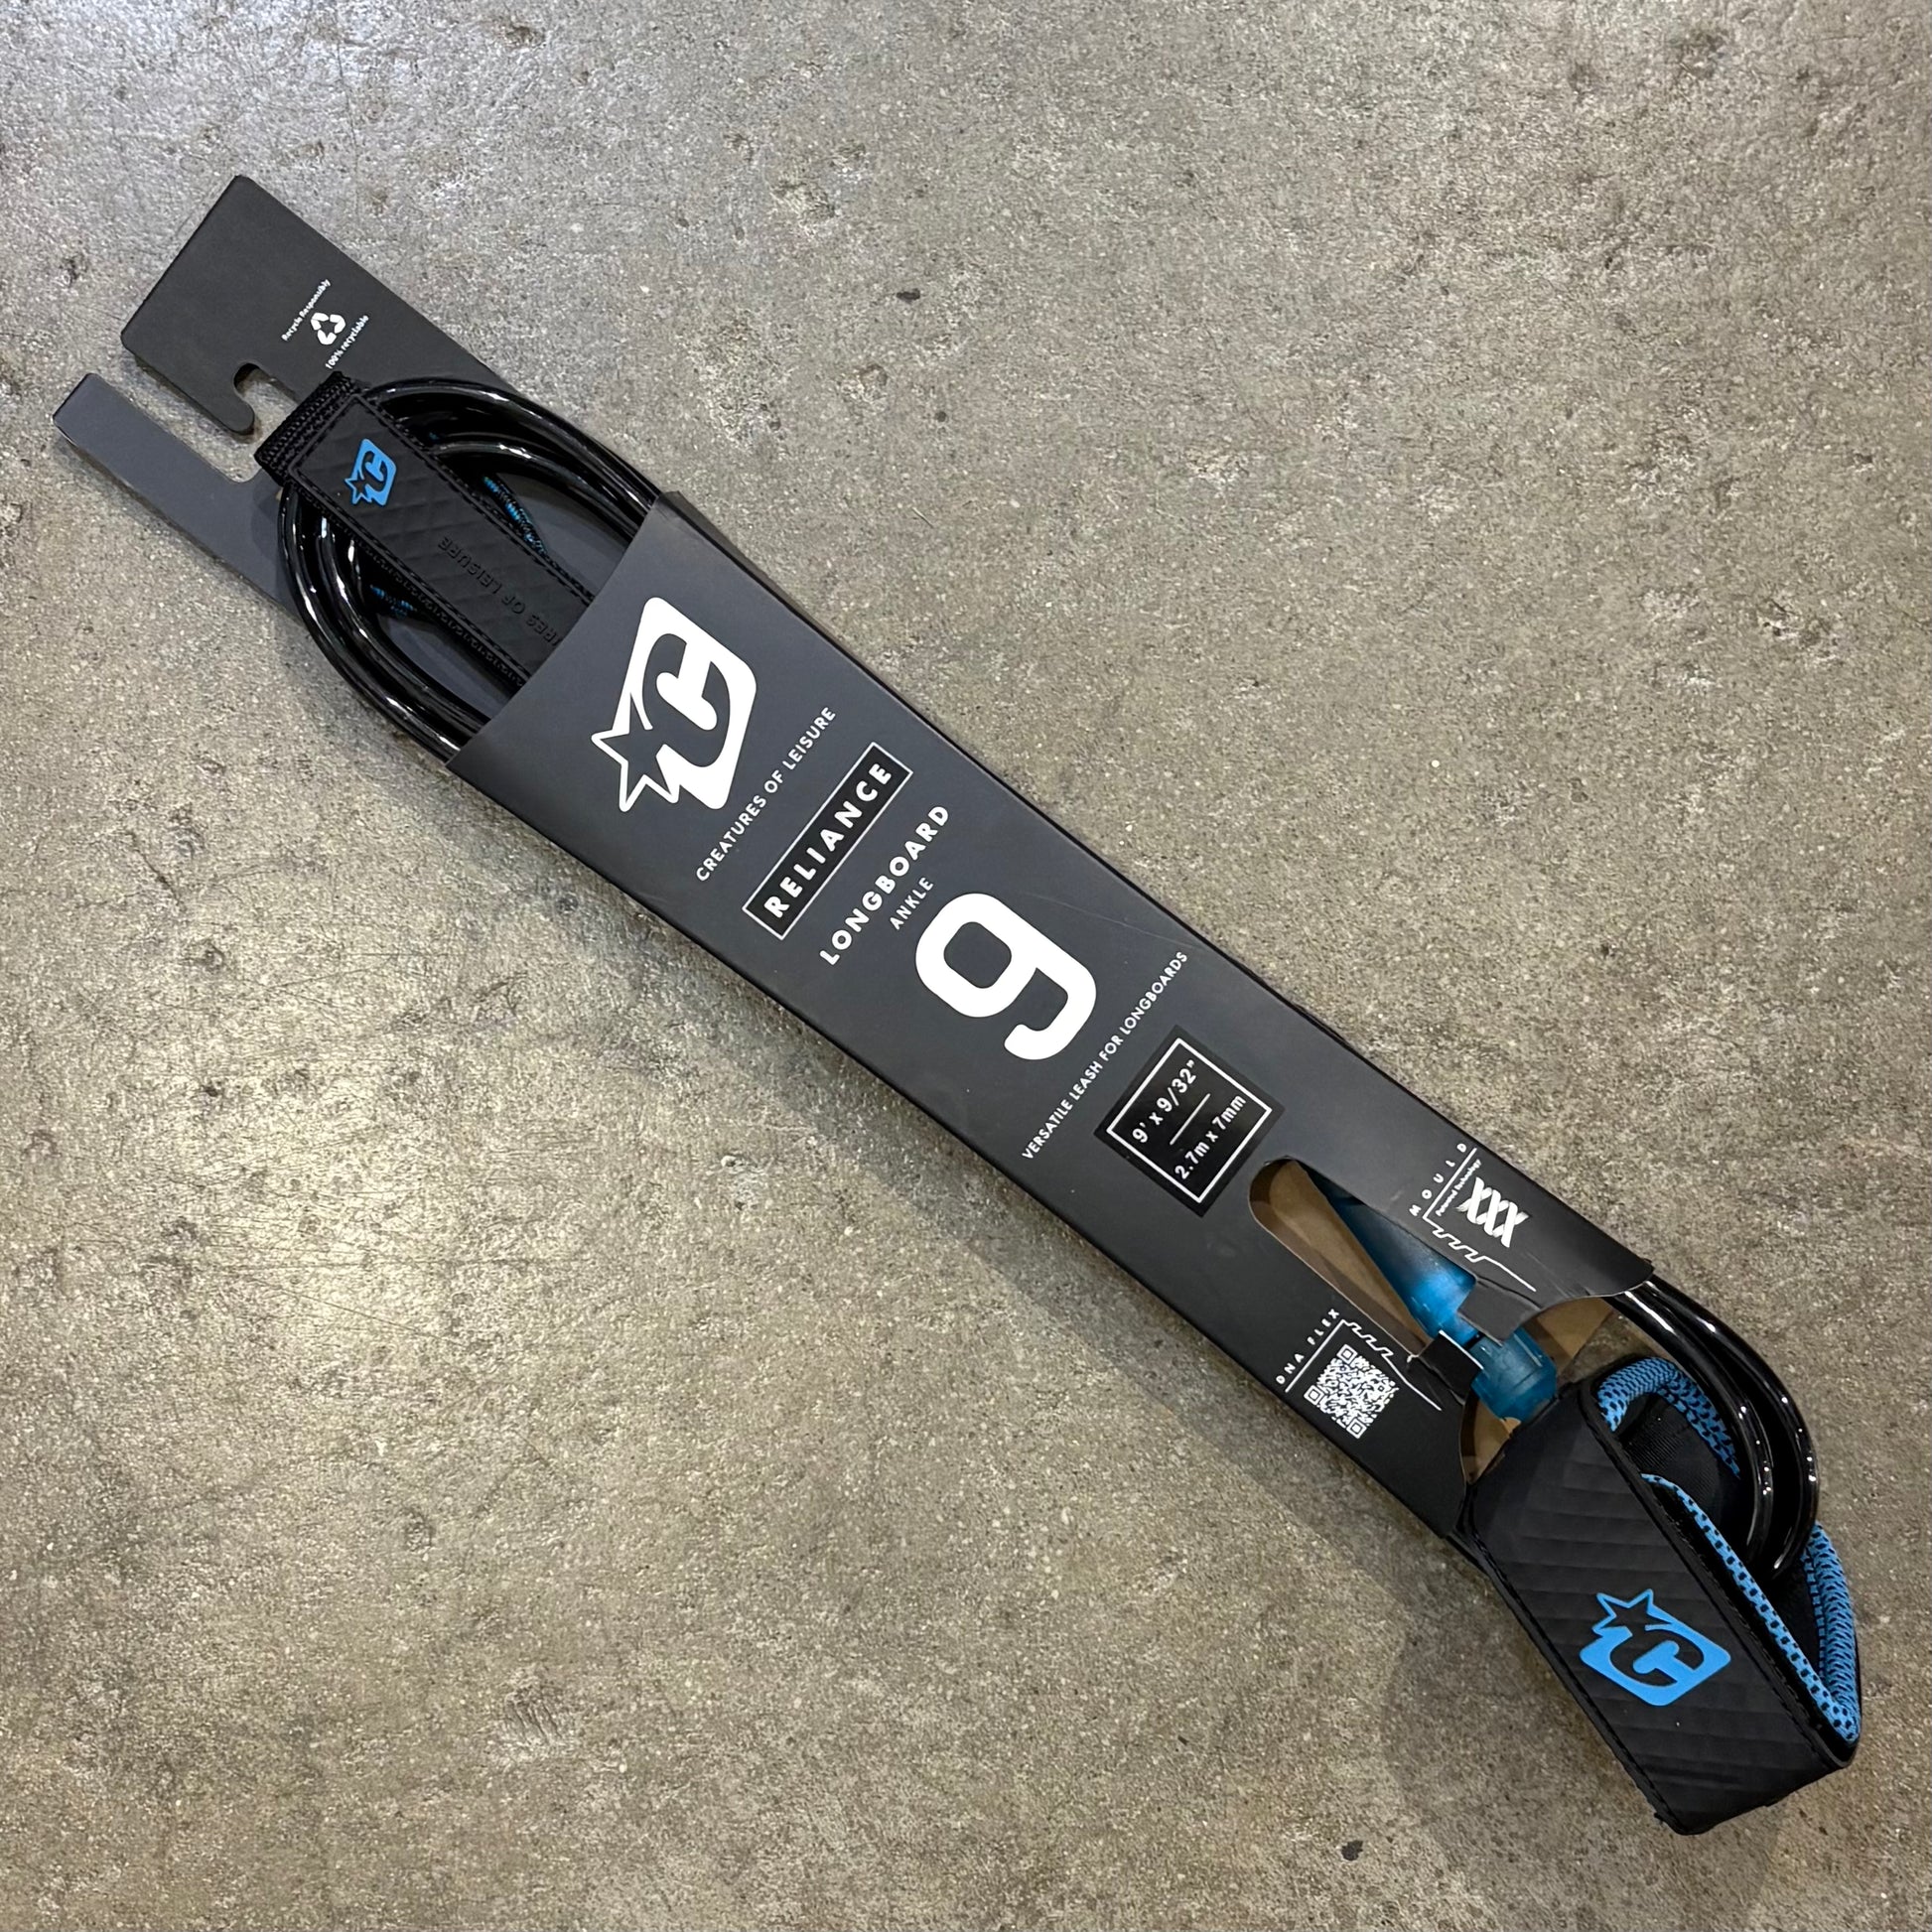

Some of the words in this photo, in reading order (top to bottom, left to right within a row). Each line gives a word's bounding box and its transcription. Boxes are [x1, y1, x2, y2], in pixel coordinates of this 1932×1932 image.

[281, 317, 303, 342] Recycle
[325, 349, 344, 369] 100%
[341, 315, 369, 350] recyclable
[438, 537, 502, 595] LEISURE
[501, 596, 526, 615] OF
[695, 794, 767, 882] CREATURES
[763, 769, 784, 793] OF
[781, 707, 837, 770] LEISURE
[763, 762, 892, 918] RELIANCE
[819, 806, 949, 966] LONGBOARD
[890, 877, 934, 930] ANKLE
[914, 893, 1097, 1060] 9
[1021, 1098, 1074, 1160] VERSATILE
[1068, 1060, 1104, 1101] LEASH
[1098, 1035, 1124, 1061] FOR
[1119, 951, 1187, 1035] LONGBOARDS
[1156, 1059, 1196, 1113] 9/32"
[1211, 1095, 1246, 1130] 7mm
[1132, 1122, 1149, 1143] 9'
[1149, 1111, 1164, 1126] x
[1205, 1130, 1219, 1143] x
[1174, 1141, 1210, 1179] 2.7m
[1409, 1143, 1467, 1216] MOULD
[1275, 1353, 1305, 1384] DNA
[1307, 1309, 1339, 1345] FLEX
